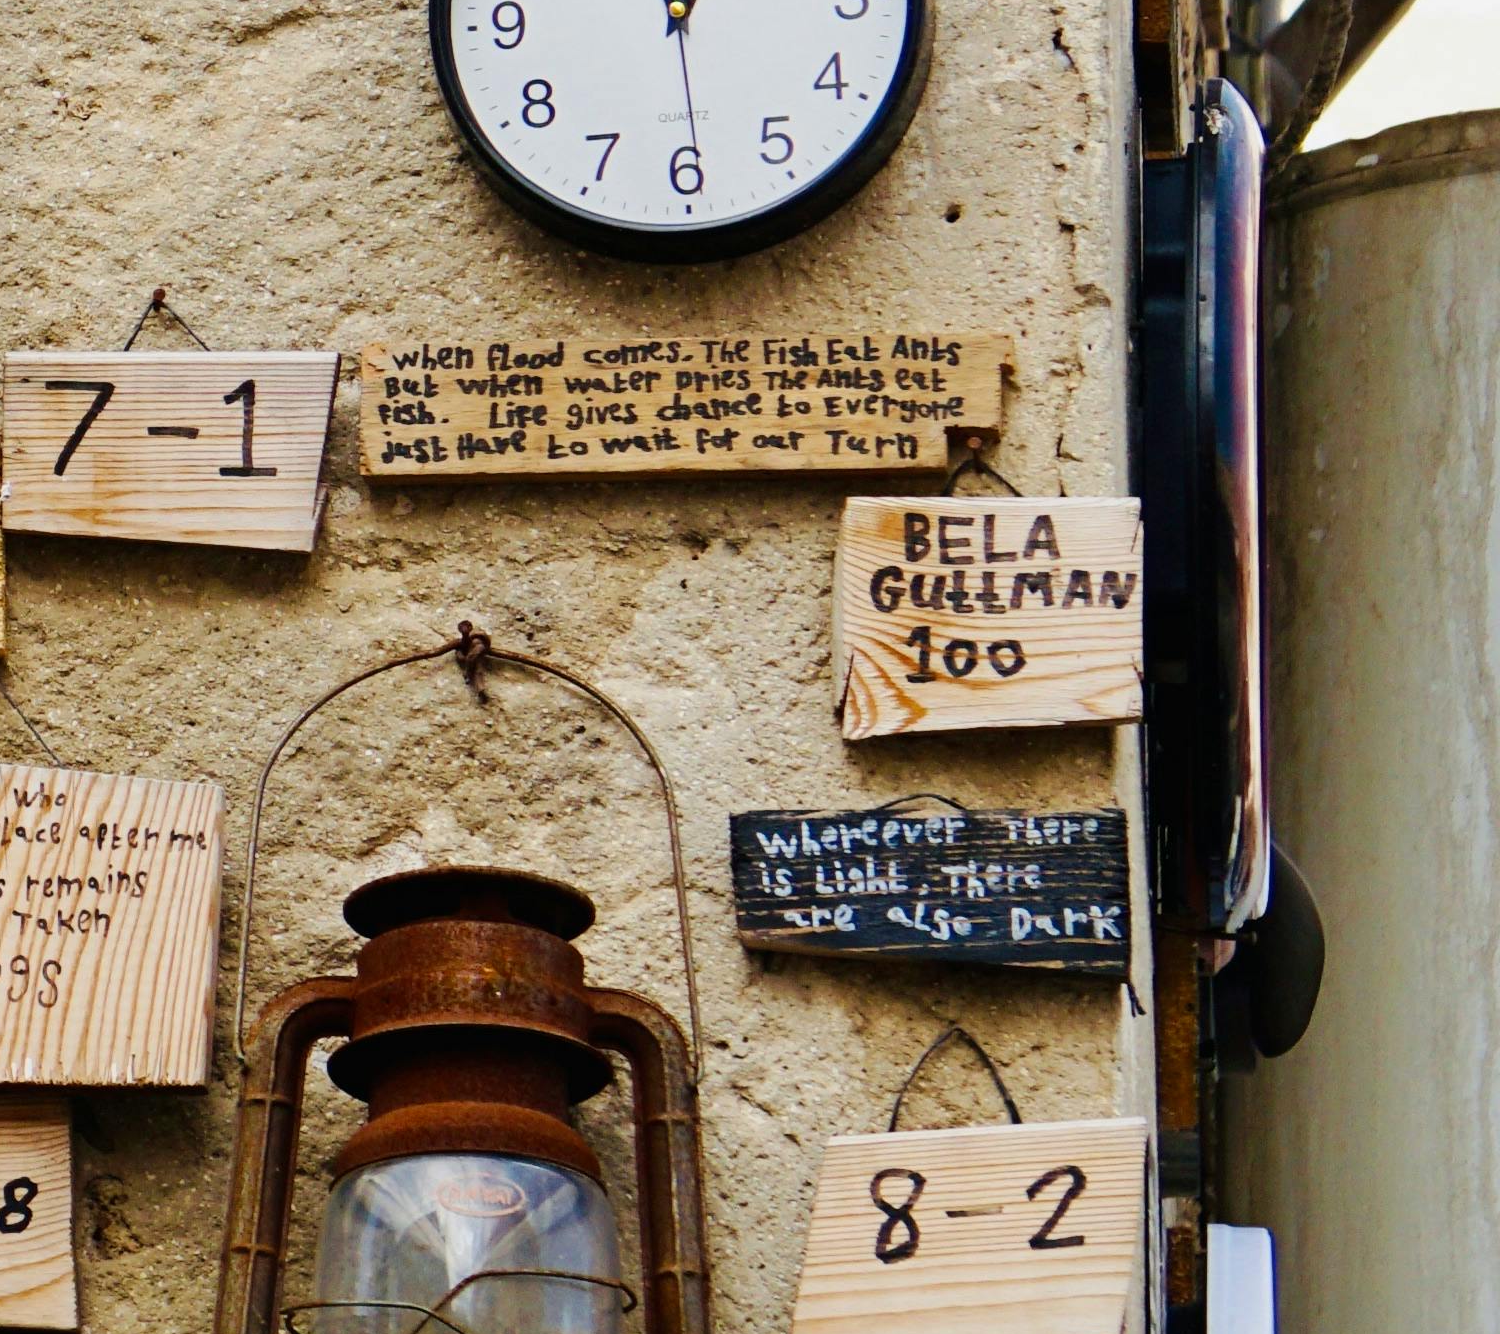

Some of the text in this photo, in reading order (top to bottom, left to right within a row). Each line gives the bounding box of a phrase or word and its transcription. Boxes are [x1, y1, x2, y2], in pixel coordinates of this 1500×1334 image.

[492, 1, 526, 49] 9
[813, 53, 850, 102] 4
[522, 79, 555, 129] 8
[586, 134, 620, 183] 7
[759, 117, 794, 167] 5
[669, 146, 704, 195] 6
[778, 395, 811, 417] to
[548, 434, 588, 459] to
[904, 513, 1061, 564] BELA
[906, 626, 1026, 683] 100
[14, 784, 66, 807] who
[758, 863, 793, 897] is
